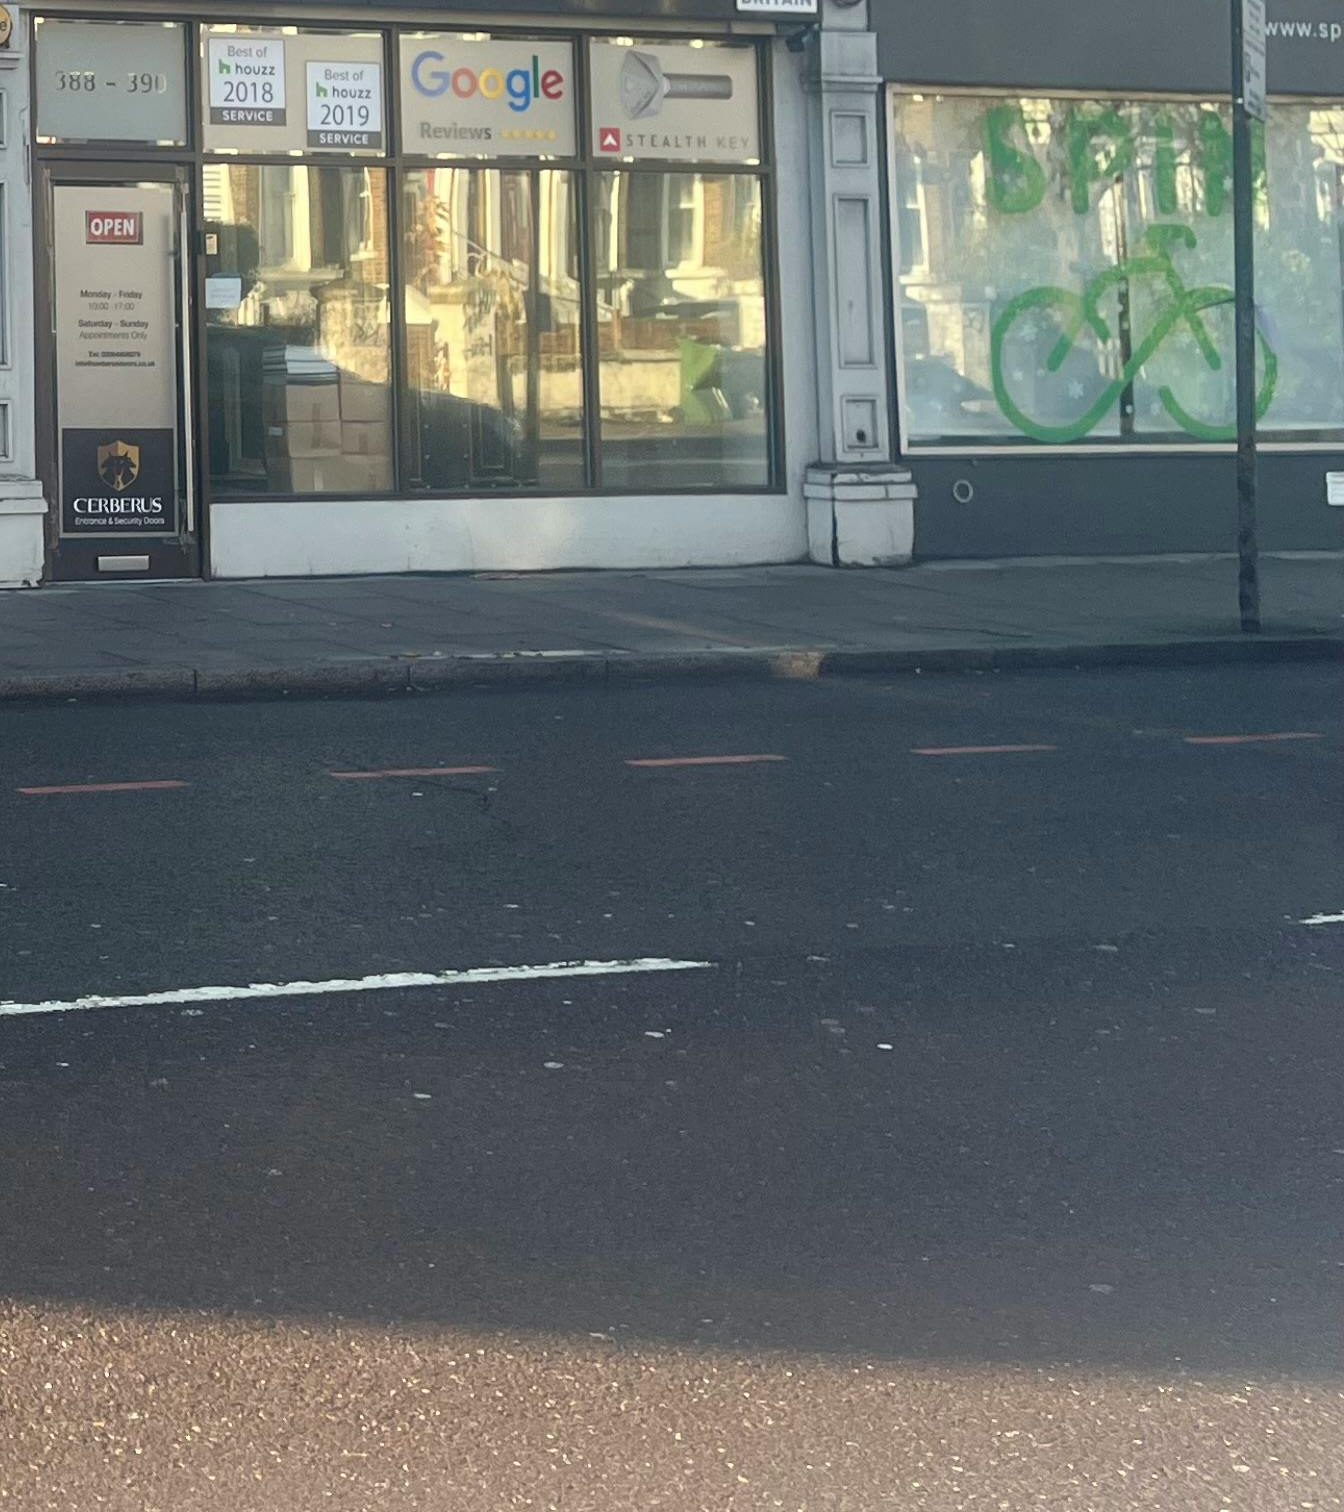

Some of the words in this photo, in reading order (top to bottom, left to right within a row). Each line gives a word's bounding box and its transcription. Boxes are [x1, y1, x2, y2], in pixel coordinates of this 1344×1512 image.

[1264, 21, 1344, 43] www.sp
[227, 45, 253, 58] Best
[255, 46, 269, 58] of
[234, 62, 276, 76] houzz
[324, 68, 349, 81] Best
[352, 69, 364, 82] of
[55, 70, 96, 92] 388
[127, 72, 167, 94] 390
[411, 50, 564, 113] Google
[223, 80, 274, 103] 2018
[332, 85, 372, 99] houzz
[222, 109, 273, 122] SERVICE
[320, 103, 369, 127] 2019
[420, 122, 492, 140] Reviews
[319, 132, 369, 145] SERVICE
[626, 134, 707, 149] STEALTH
[716, 135, 750, 151] KEY
[90, 218, 135, 236] OPEN
[80, 289, 111, 300] Monday
[118, 290, 143, 300] Friday
[78, 319, 113, 329] Saturday
[120, 319, 149, 330] Sunday
[79, 331, 130, 341] Appointments
[131, 331, 148, 341] Only
[73, 496, 163, 514] CERBERUS
[74, 516, 107, 526] Entrance
[108, 517, 114, 525] &
[114, 516, 143, 527] Security
[143, 516, 166, 525] Doors
